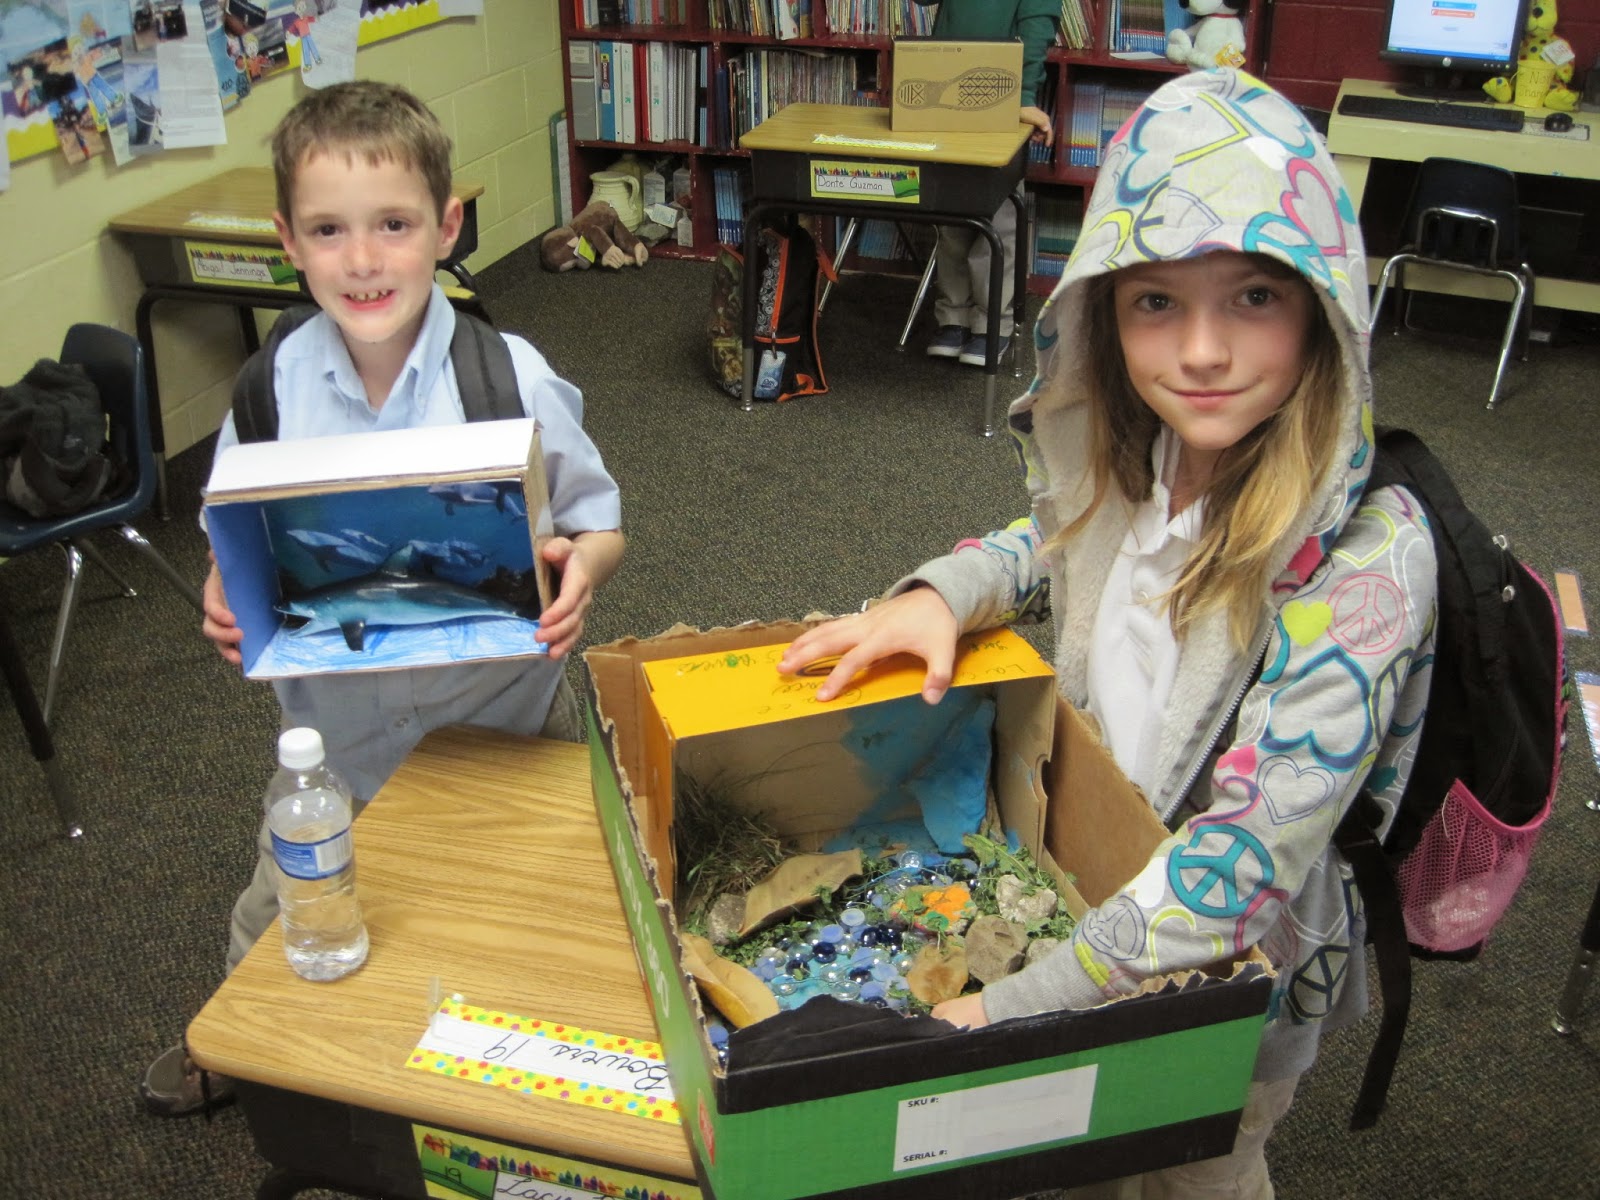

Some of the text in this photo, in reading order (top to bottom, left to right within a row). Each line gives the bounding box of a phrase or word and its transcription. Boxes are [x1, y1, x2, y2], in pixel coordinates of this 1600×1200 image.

[849, 176, 883, 190] Guzman
[230, 261, 266, 281] Jennings
[483, 1033, 668, 1091] Bowers 19
[907, 1098, 928, 1108] SKU
[903, 1151, 936, 1163] SERIAL
[444, 1165, 462, 1184] 19
